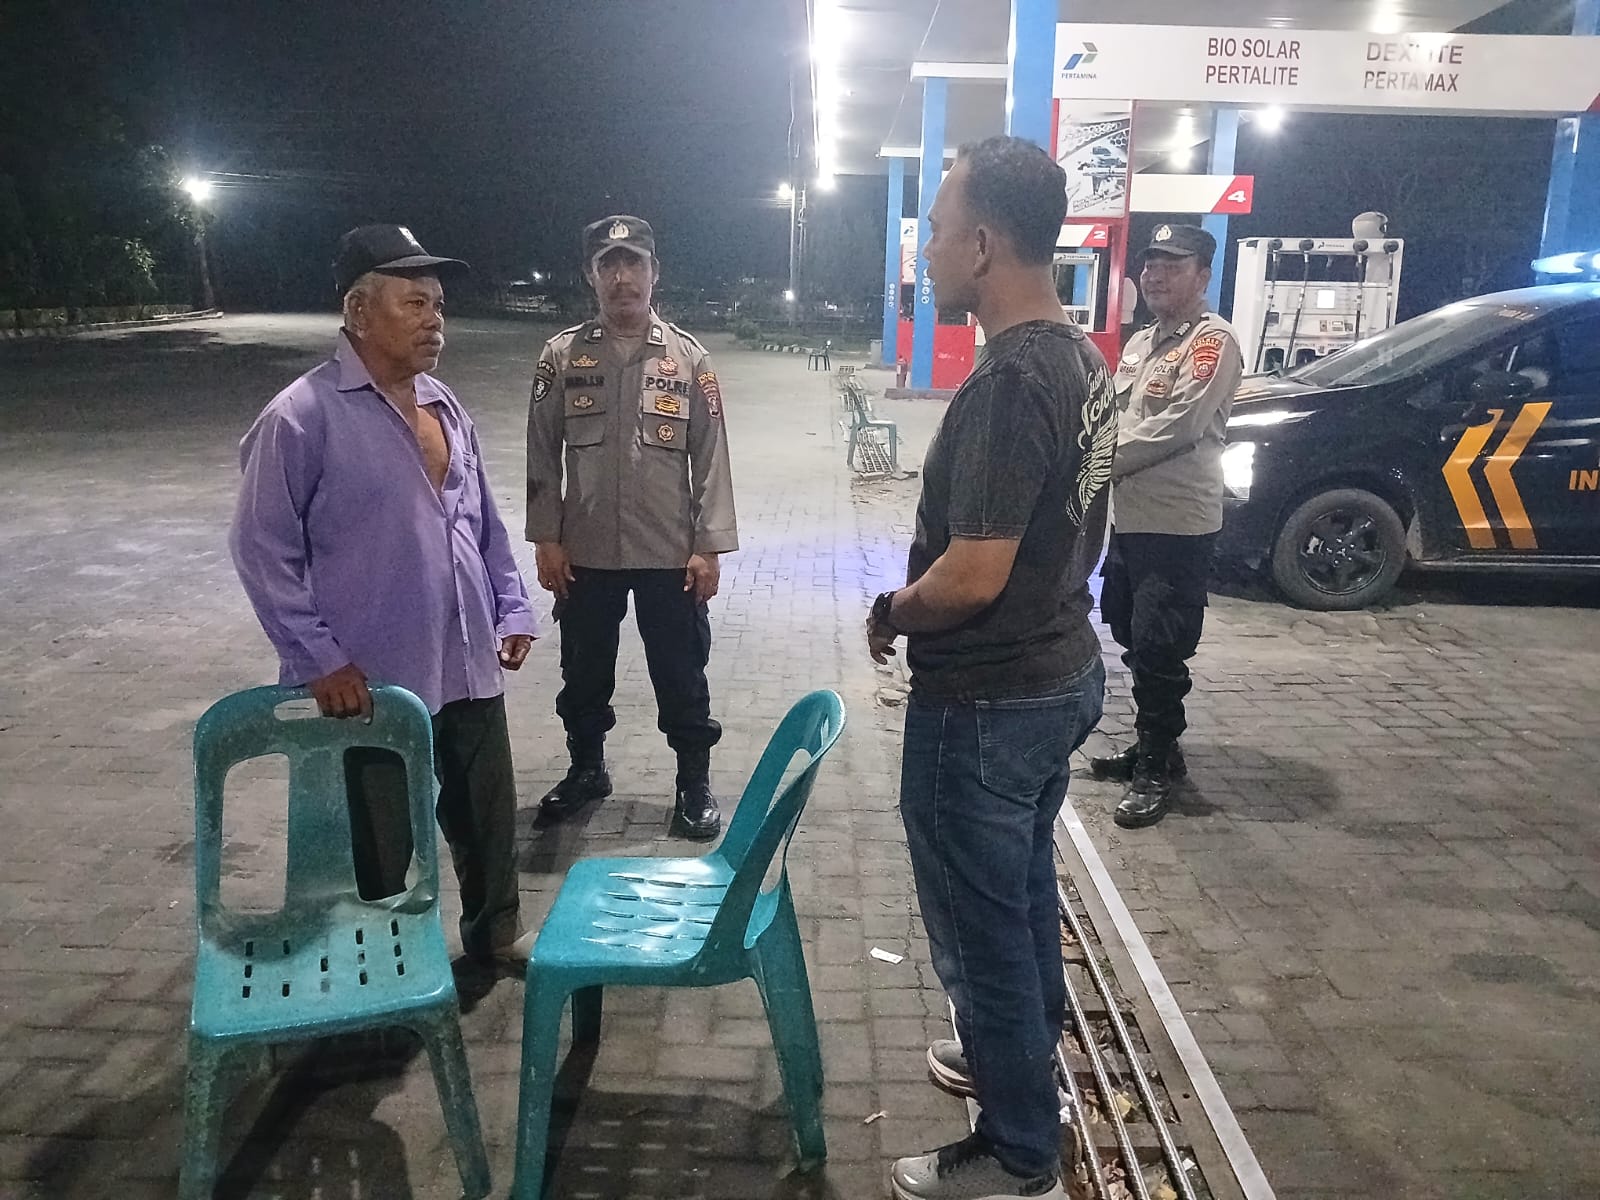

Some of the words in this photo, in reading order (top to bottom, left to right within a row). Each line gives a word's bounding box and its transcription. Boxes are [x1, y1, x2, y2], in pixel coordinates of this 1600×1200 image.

[1207, 37, 1237, 57] BIO
[1242, 38, 1301, 59] SOLAR
[1205, 65, 1300, 86] PERTALITE
[1363, 70, 1460, 92] PERTAMAX
[1227, 190, 1247, 203] 4
[1093, 230, 1106, 240] 2
